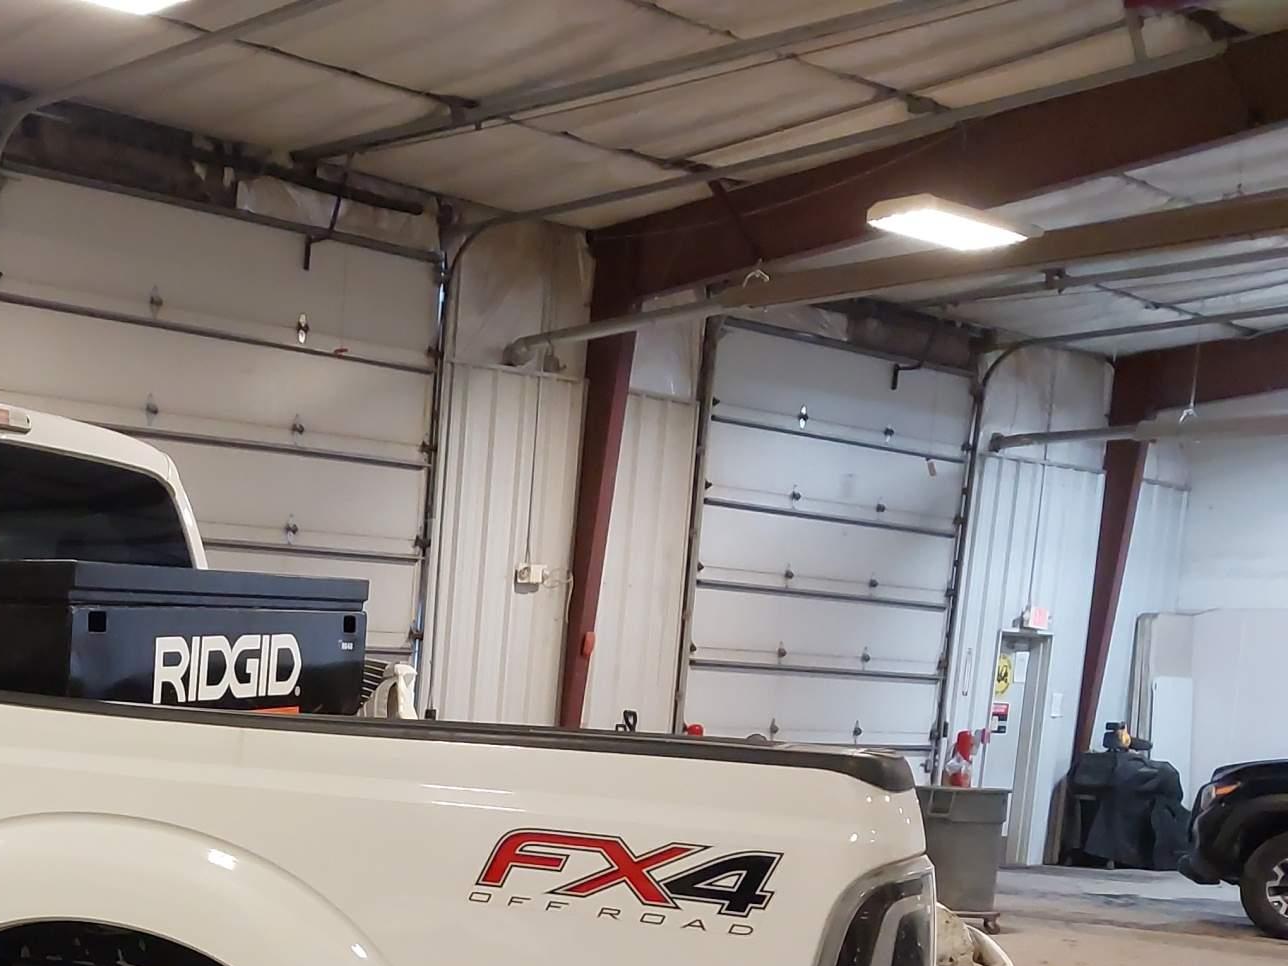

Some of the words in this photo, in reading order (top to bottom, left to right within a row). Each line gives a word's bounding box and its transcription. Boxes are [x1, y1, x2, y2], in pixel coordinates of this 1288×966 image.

[476, 828, 785, 919] FX4
[469, 891, 570, 912] OFF
[597, 907, 754, 936] ROAD
